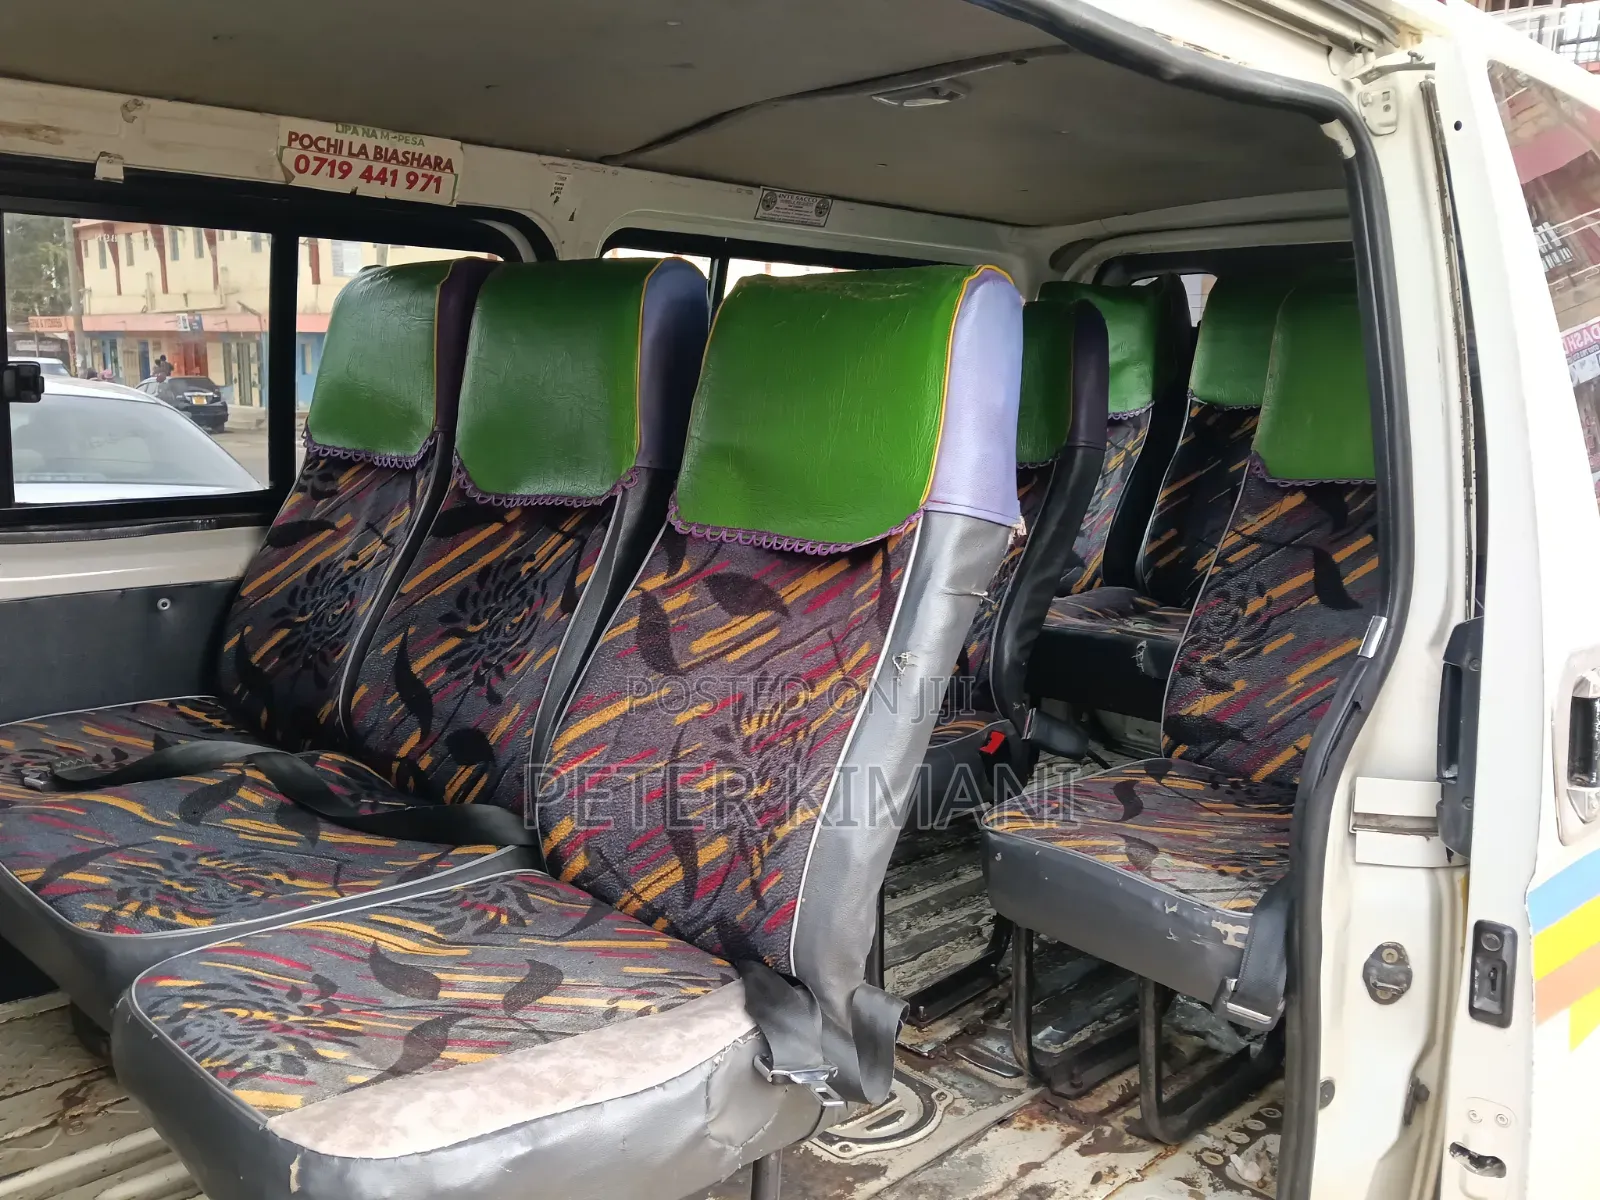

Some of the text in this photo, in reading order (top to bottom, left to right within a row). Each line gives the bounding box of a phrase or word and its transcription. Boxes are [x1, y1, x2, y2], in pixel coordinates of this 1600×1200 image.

[287, 130, 455, 173] POCHI LA BIASHARA
[335, 123, 426, 147] LIPA NA M-PESA
[294, 153, 443, 194] 0719 441 971
